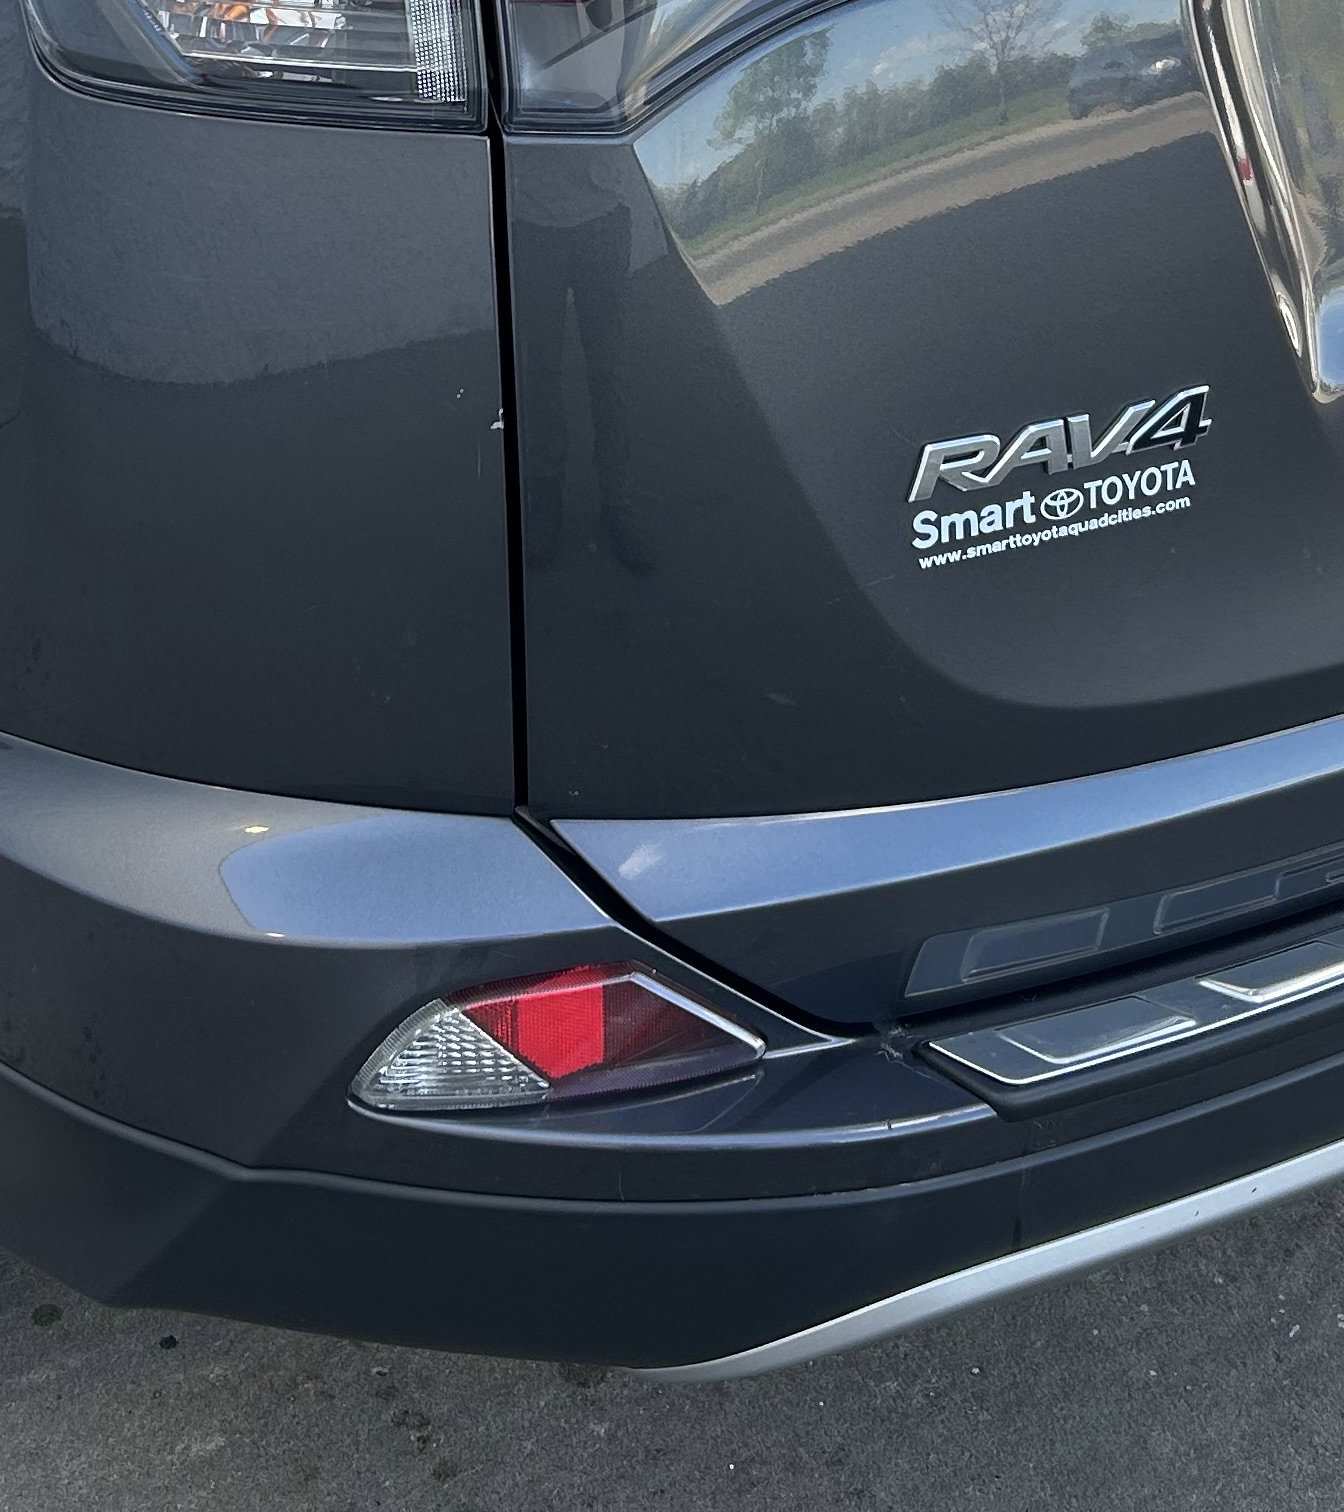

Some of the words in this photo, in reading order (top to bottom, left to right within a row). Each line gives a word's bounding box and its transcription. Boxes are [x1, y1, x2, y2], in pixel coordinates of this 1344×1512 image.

[908, 384, 1213, 503] RAV4
[911, 490, 1037, 549] Smart
[1083, 459, 1196, 509] TOYOTA
[918, 495, 1192, 570] www.smarttoyotaquadcities.com
